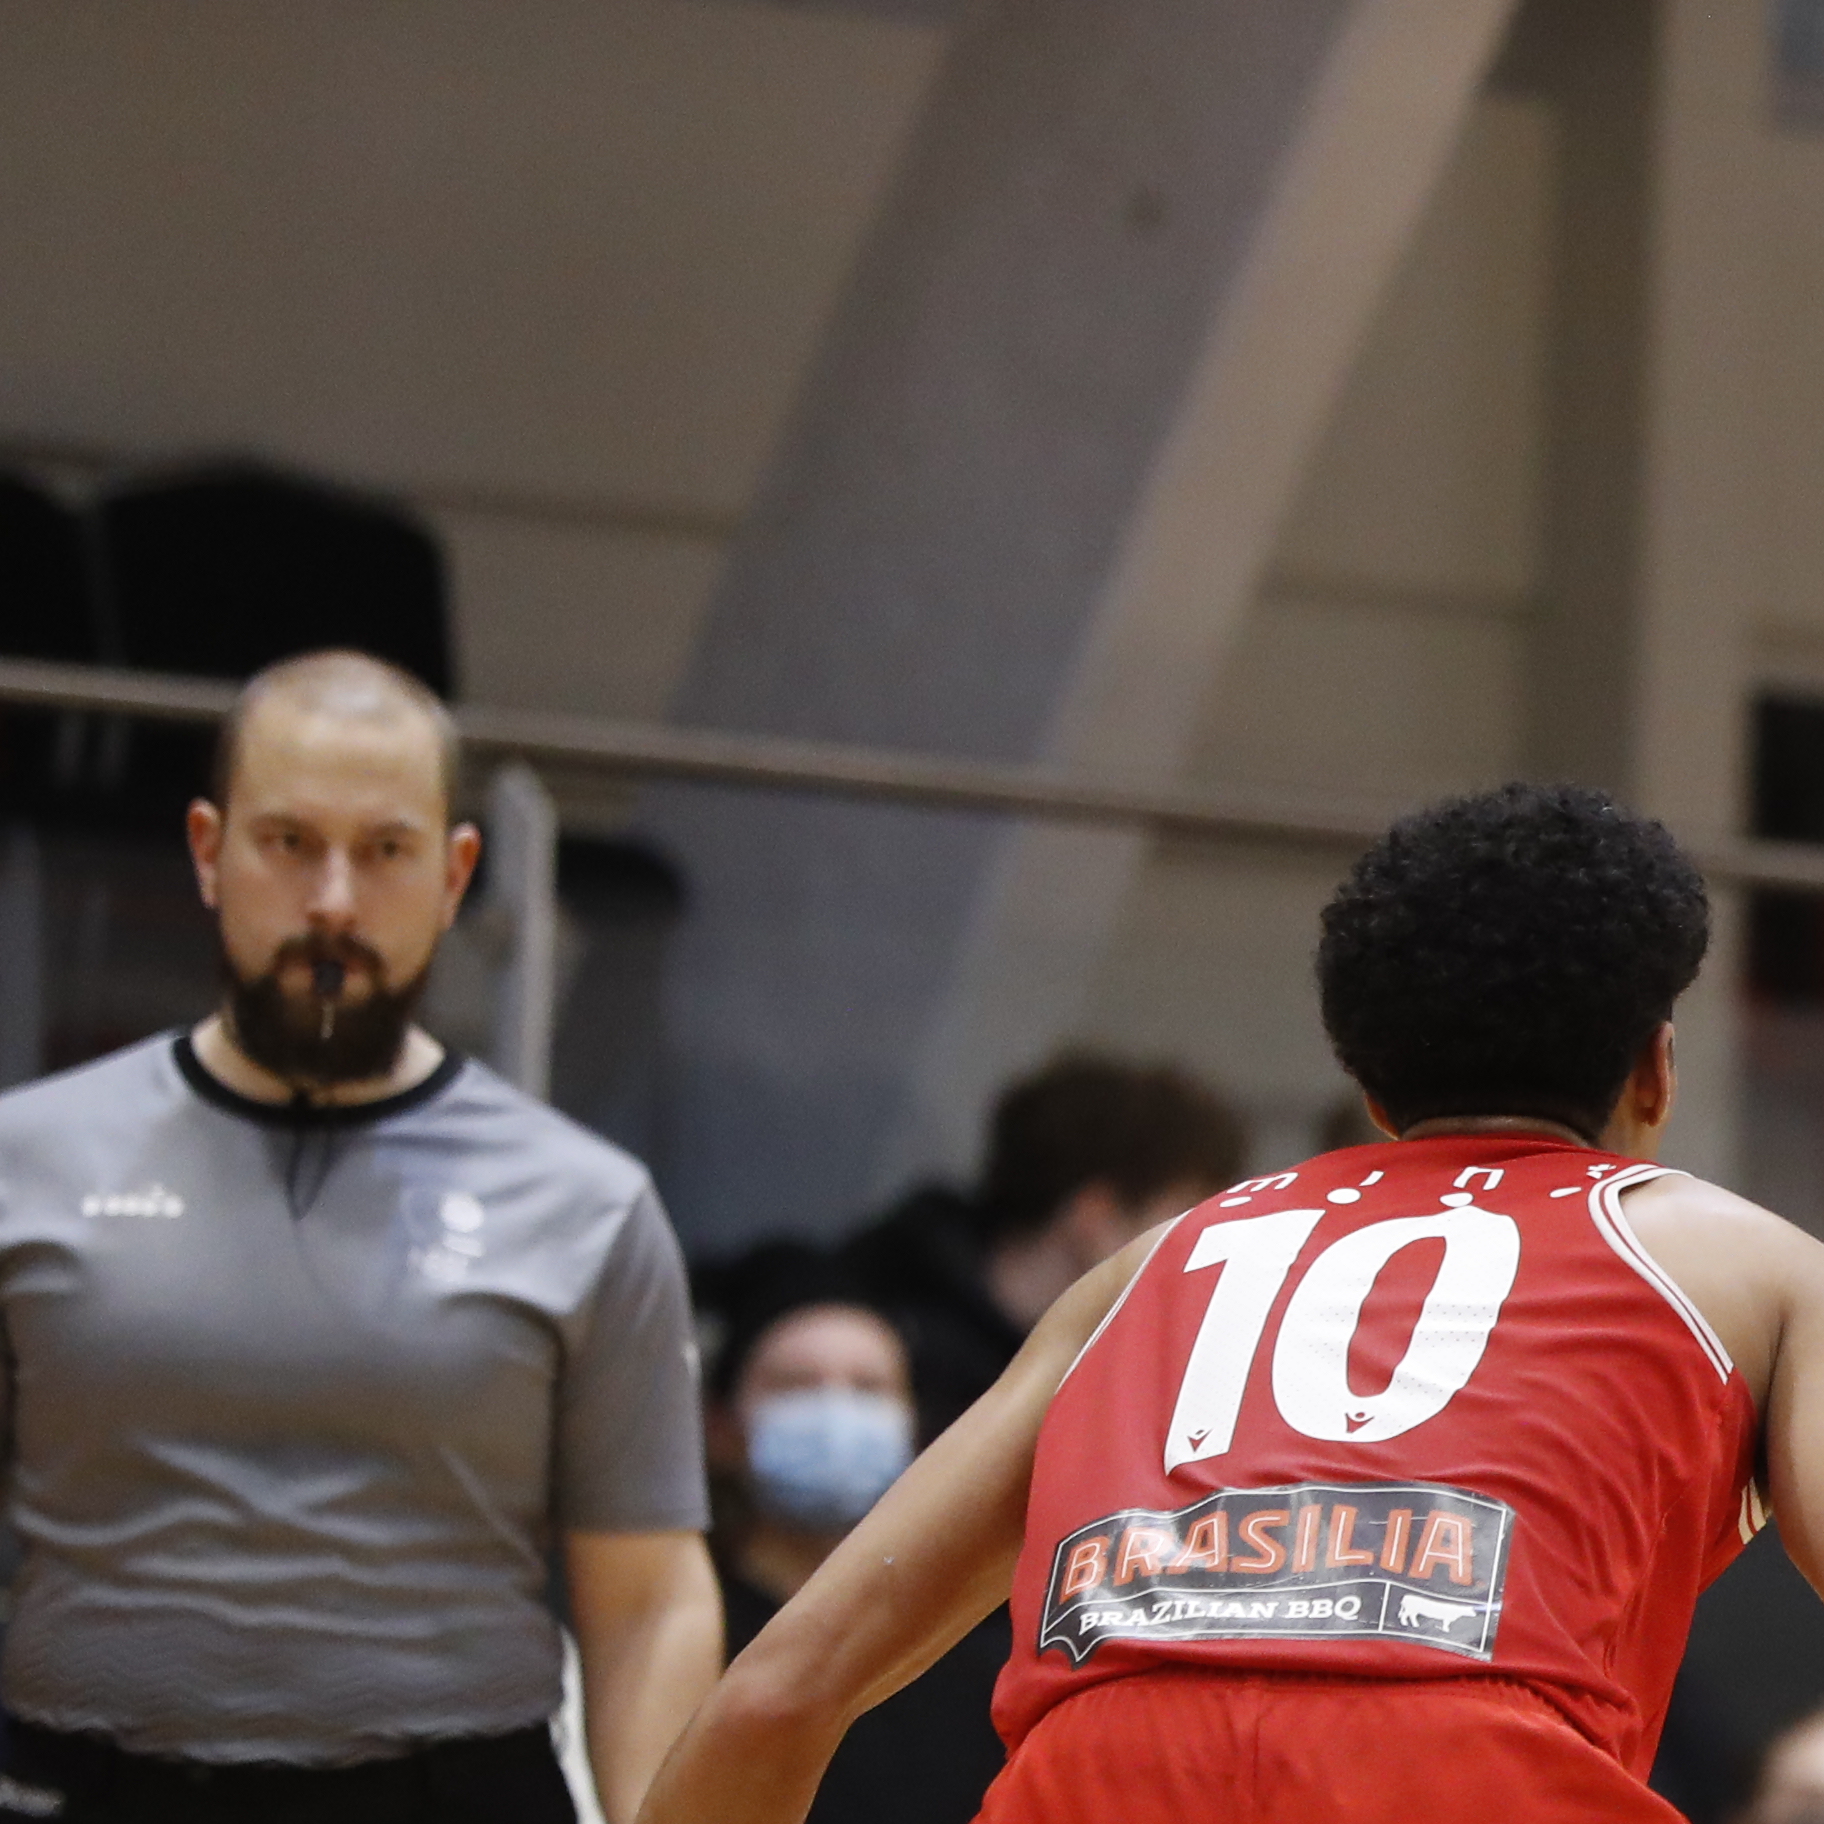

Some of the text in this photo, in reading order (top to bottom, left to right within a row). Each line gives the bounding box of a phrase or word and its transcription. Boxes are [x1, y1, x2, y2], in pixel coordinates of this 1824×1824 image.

[1164, 1205, 1520, 1476] 10
[1060, 1503, 1474, 1606] BRASILIA
[1078, 1596, 1362, 1636] BRAZILIAN BBQ
